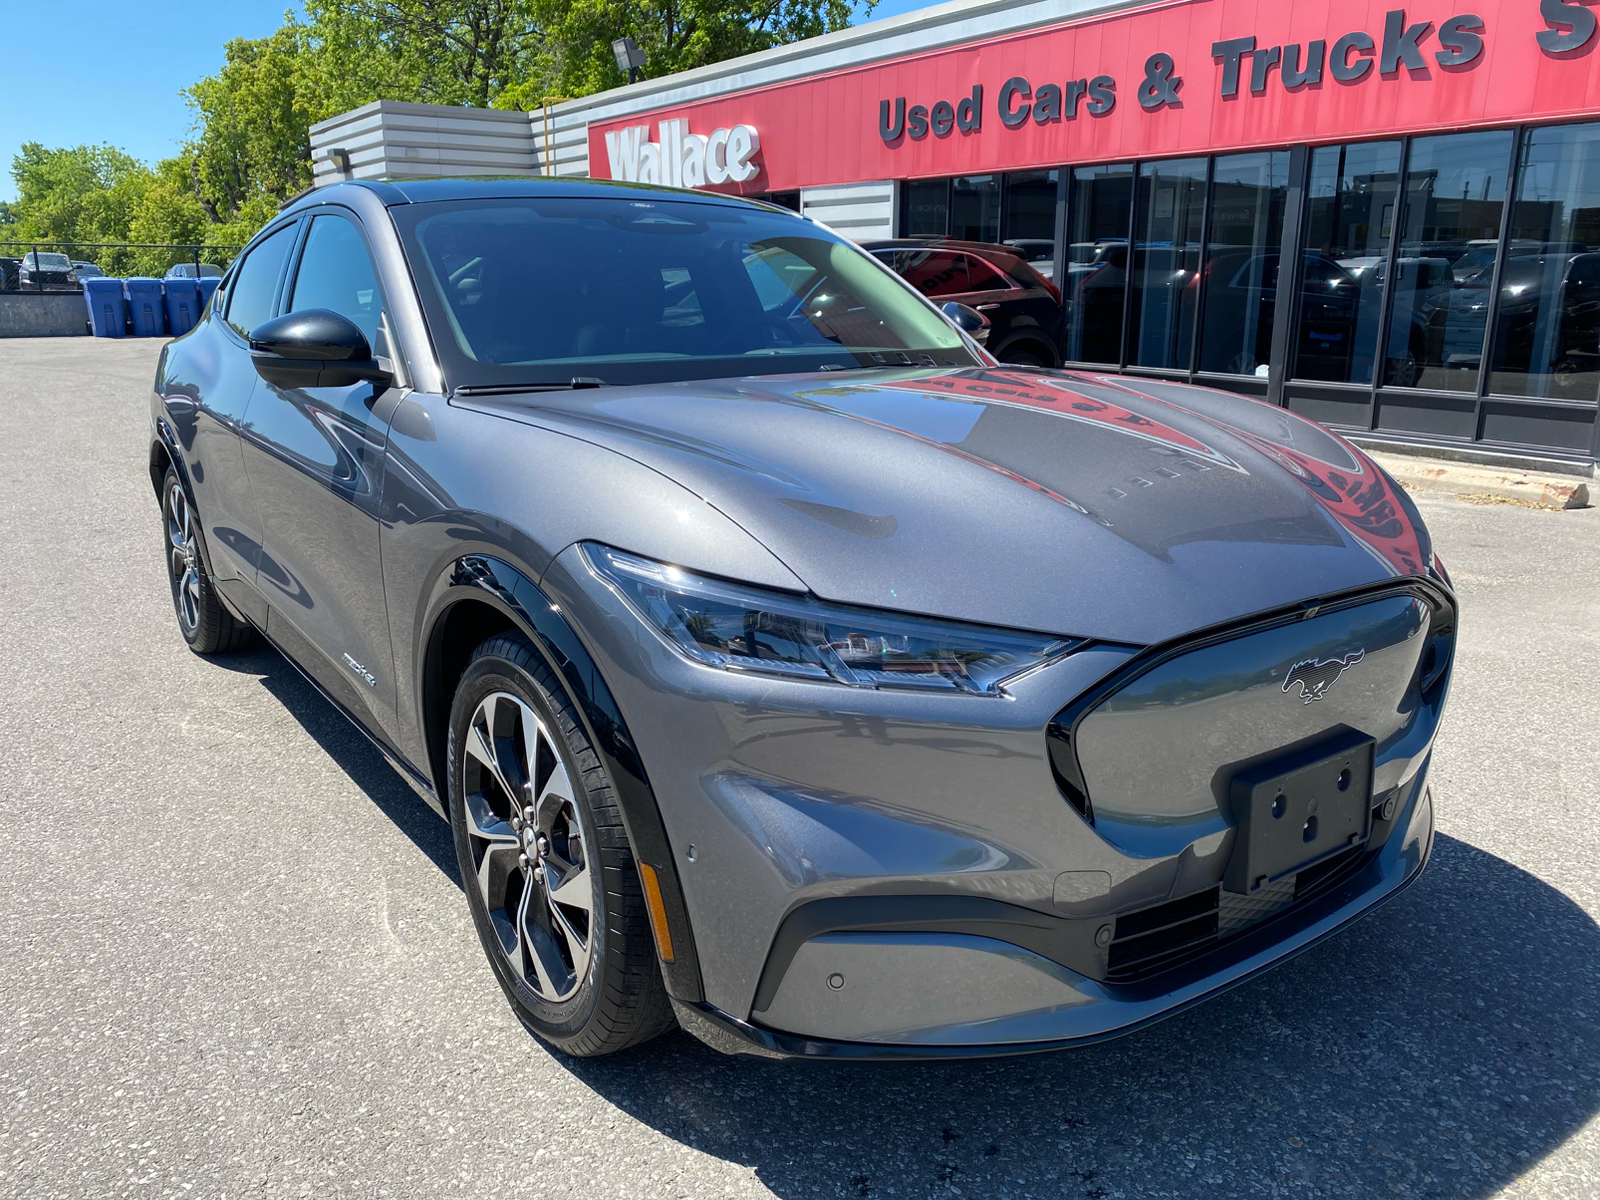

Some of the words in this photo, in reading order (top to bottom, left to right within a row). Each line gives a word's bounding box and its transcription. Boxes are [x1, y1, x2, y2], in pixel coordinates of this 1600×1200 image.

[879, 84, 983, 142] Used
[998, 75, 1116, 127] Cars
[1137, 52, 1183, 108] &
[1211, 9, 1484, 96] Trucks
[605, 117, 760, 189] Wallace
